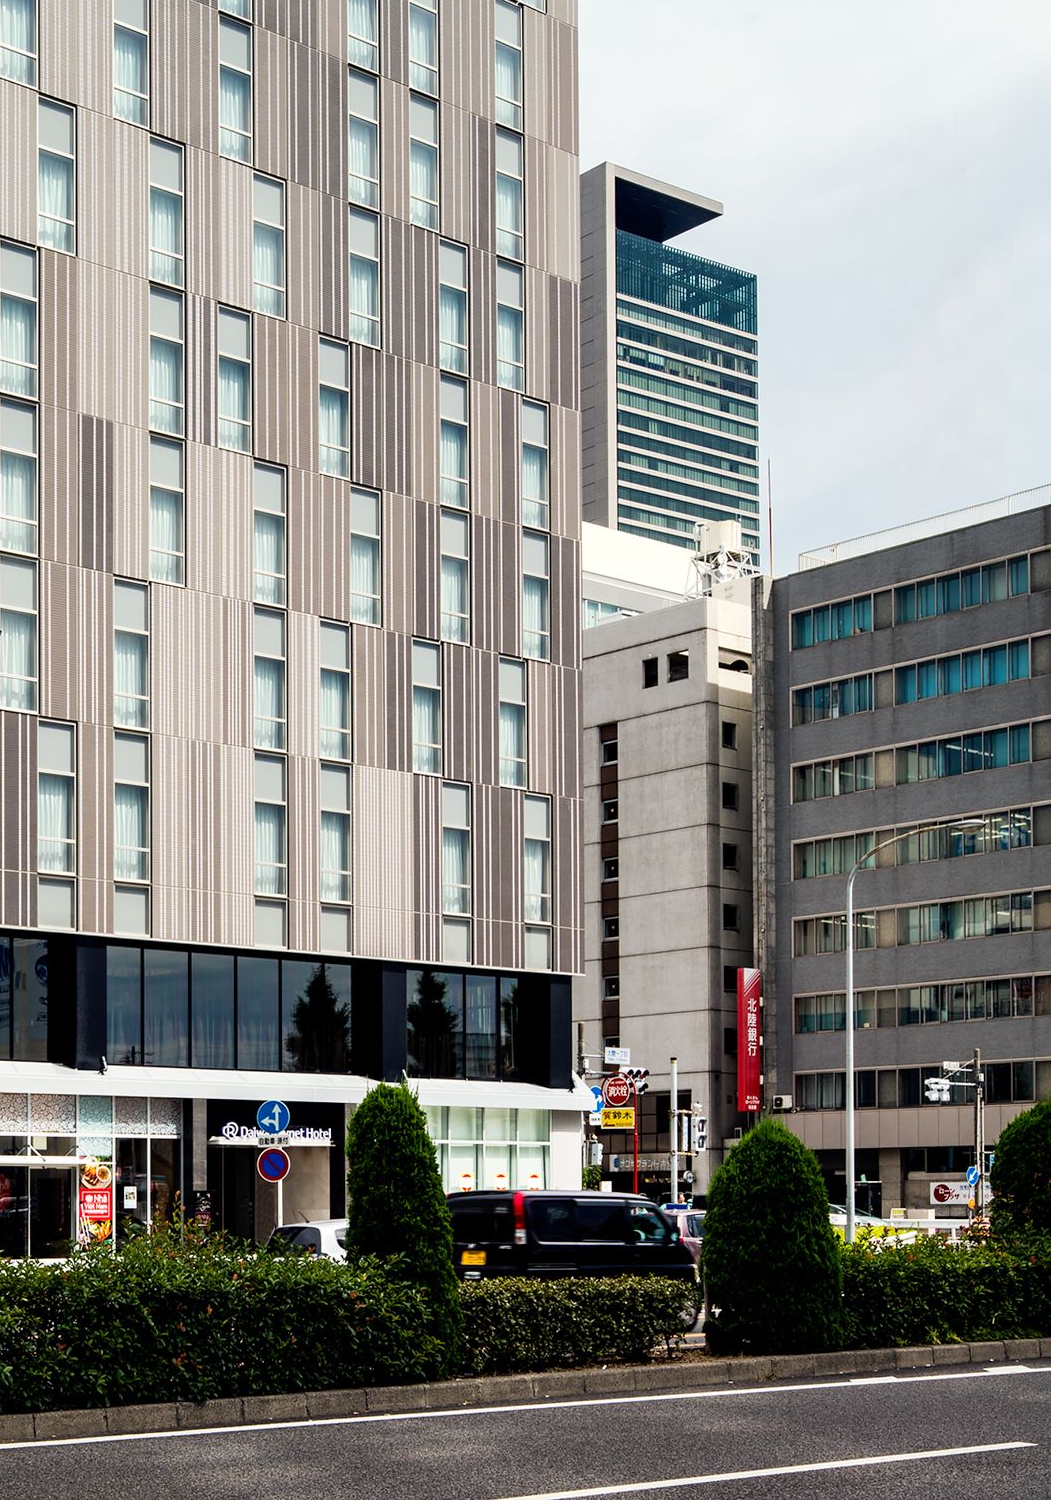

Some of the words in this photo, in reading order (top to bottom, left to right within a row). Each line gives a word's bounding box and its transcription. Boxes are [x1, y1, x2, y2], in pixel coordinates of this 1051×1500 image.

[747, 997, 757, 1057] 北陸銀行
[305, 1127, 332, 1139] Hotel
